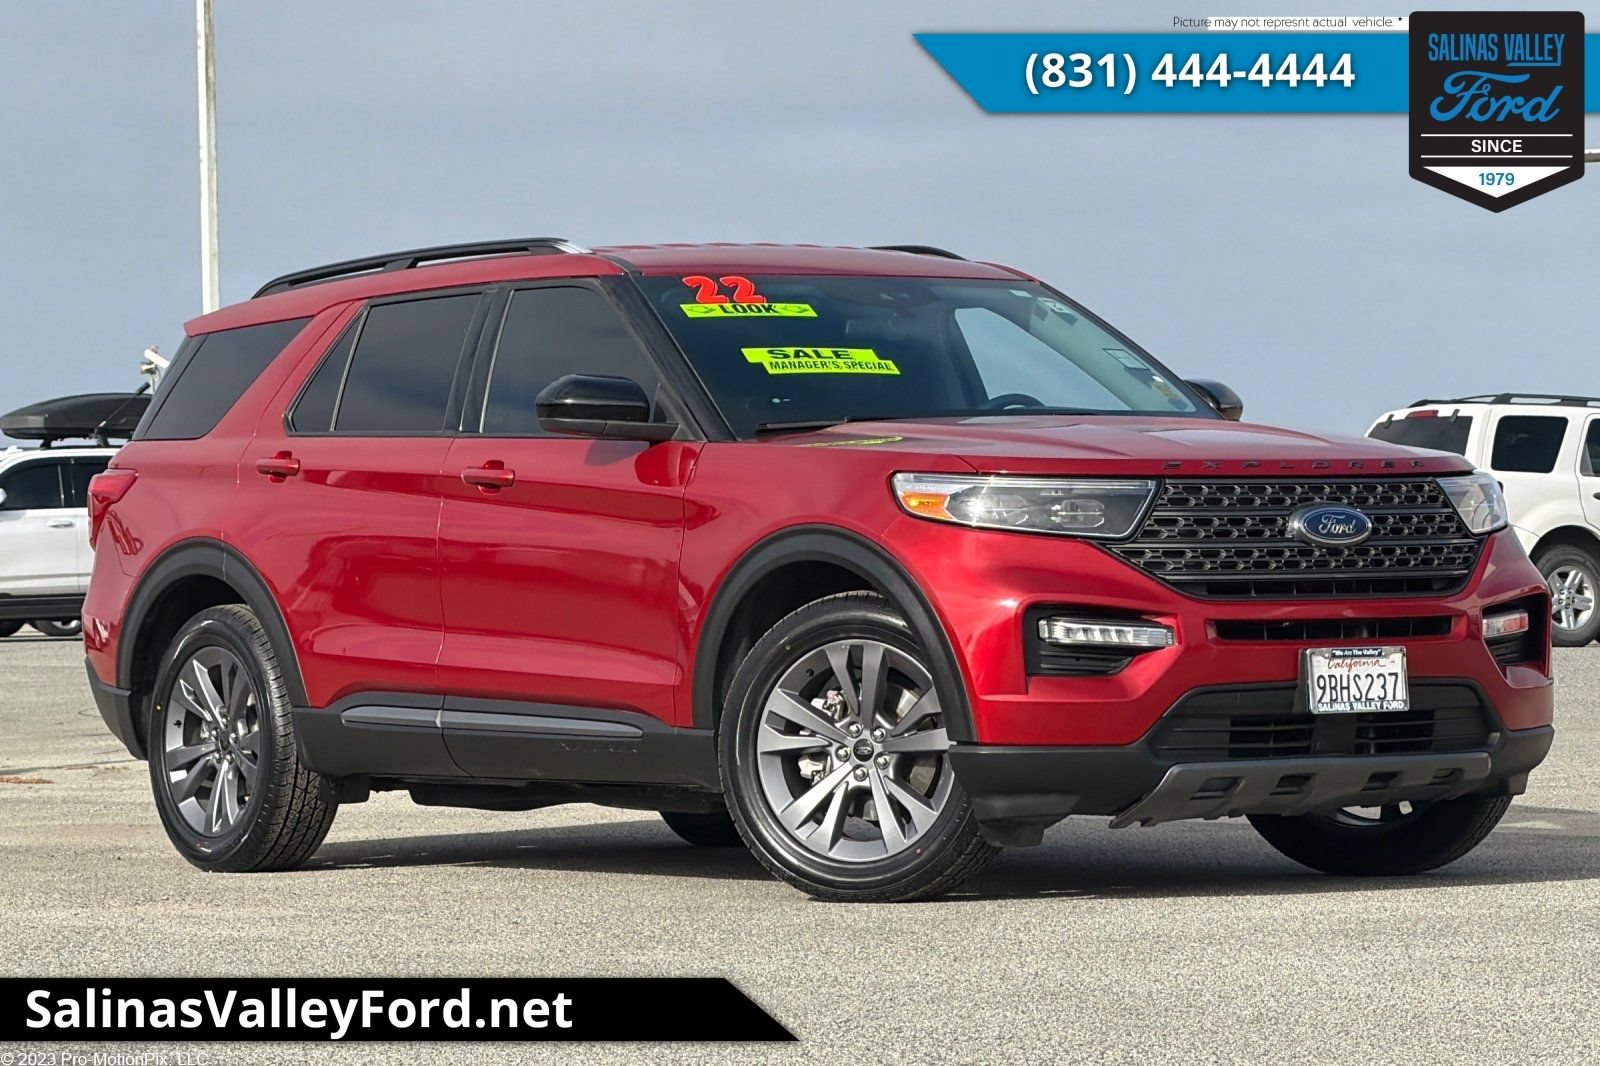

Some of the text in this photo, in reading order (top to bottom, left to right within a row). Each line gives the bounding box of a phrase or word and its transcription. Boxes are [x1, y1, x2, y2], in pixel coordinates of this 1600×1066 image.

[682, 276, 767, 304] 22
[718, 303, 778, 314] LOOK
[766, 349, 853, 360] SALE
[845, 361, 894, 371] SPECIAL
[1162, 459, 1426, 470] EXPLORER
[1318, 514, 1356, 535] Ford
[1328, 658, 1386, 672] California
[1317, 672, 1398, 702] 9BHS237
[1318, 700, 1405, 712] SALINAS VALLEY FORD
